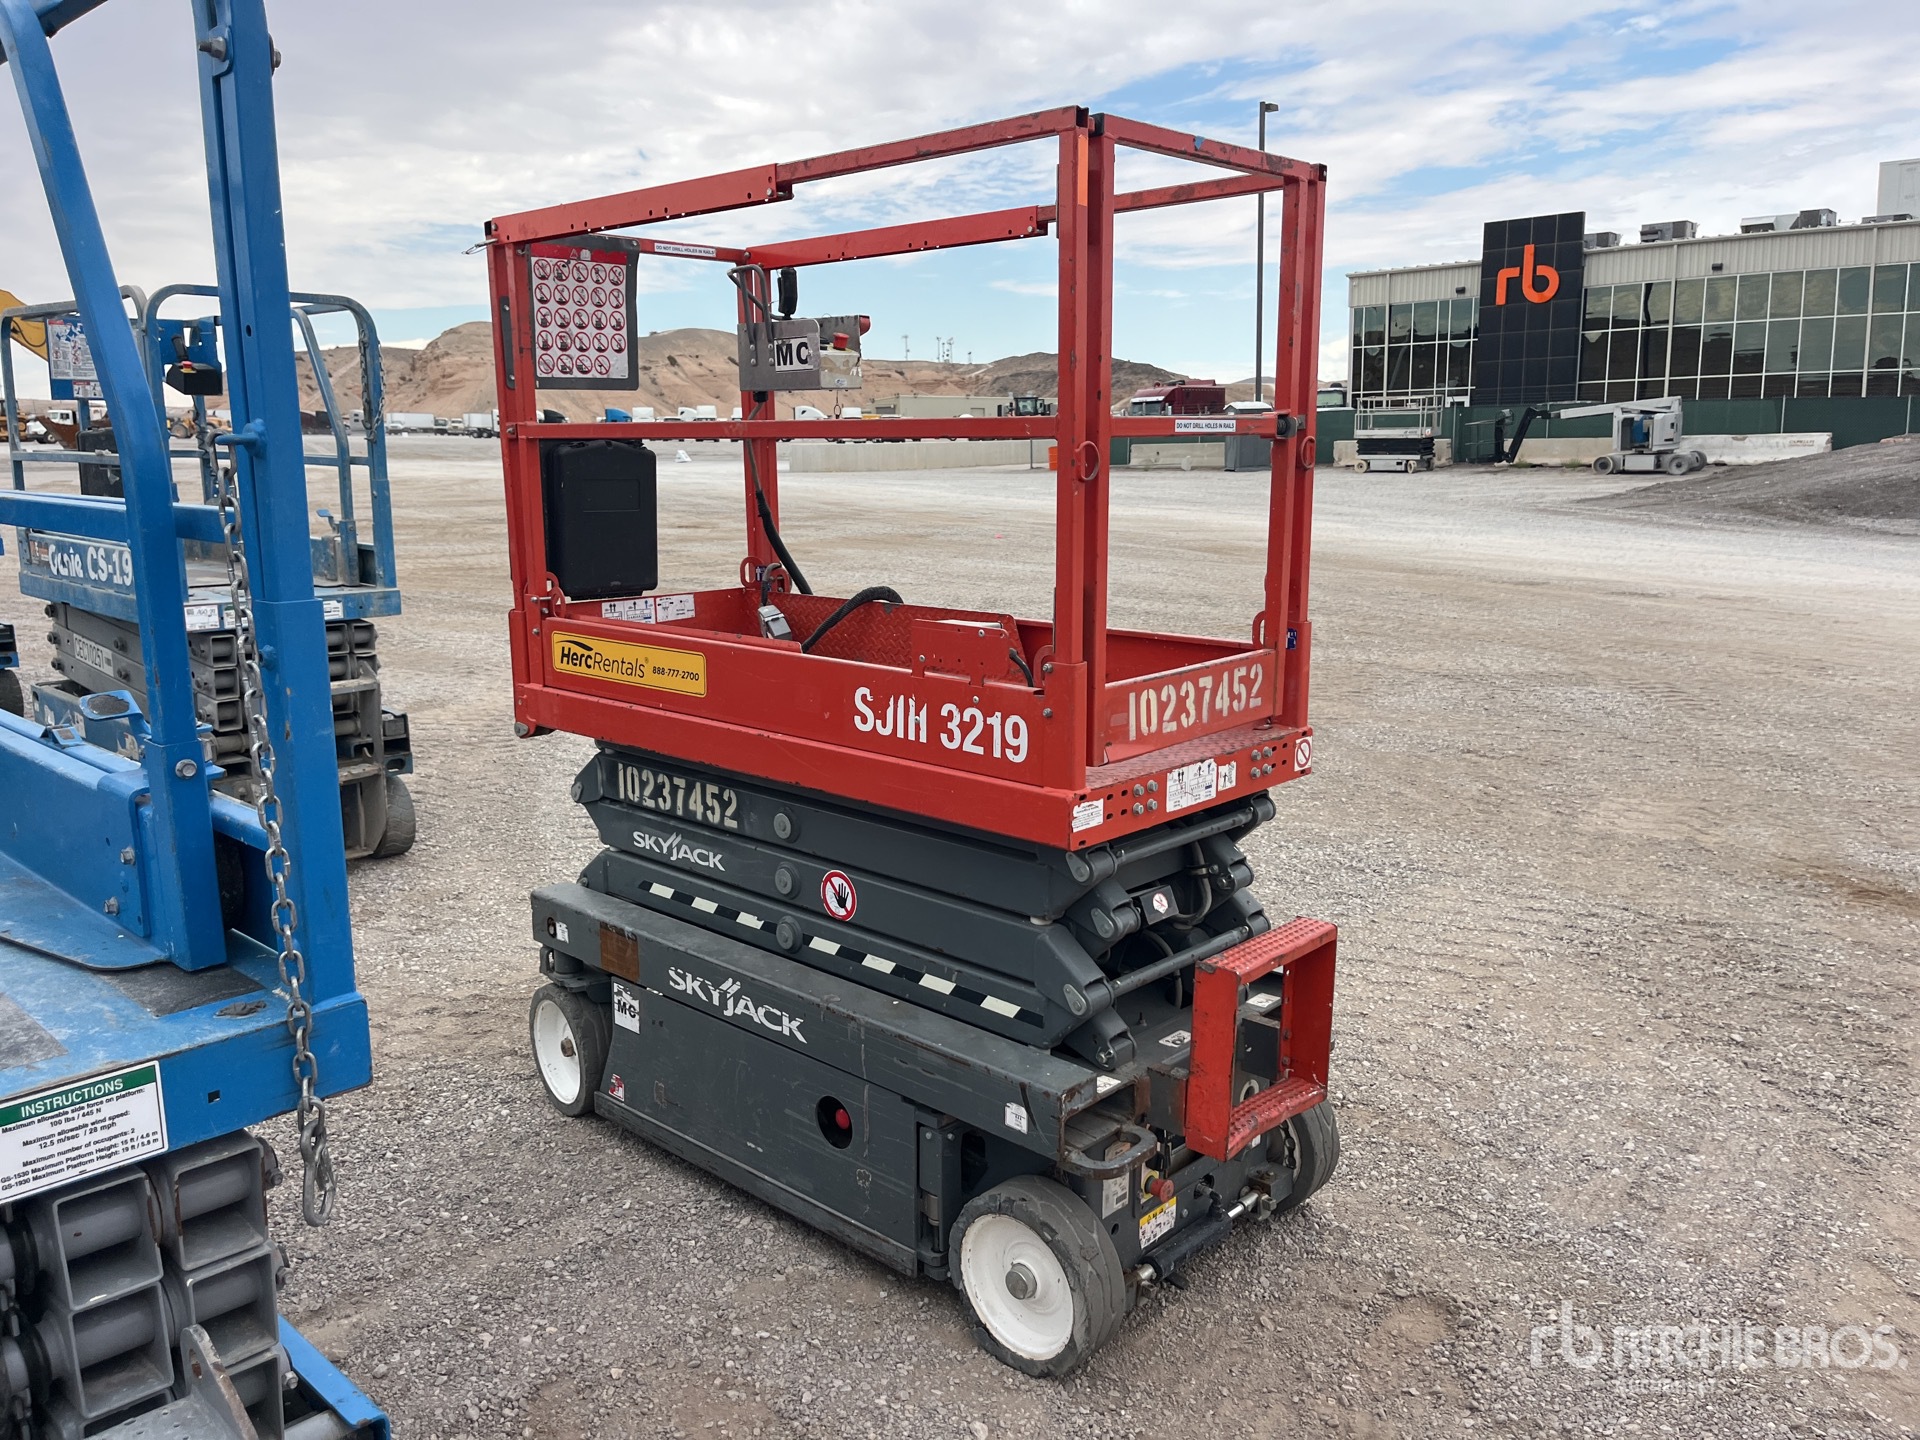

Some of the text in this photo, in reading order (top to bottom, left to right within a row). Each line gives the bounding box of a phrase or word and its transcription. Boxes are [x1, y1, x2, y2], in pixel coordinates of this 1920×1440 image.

[1495, 244, 1559, 305] rb
[776, 342, 809, 366] MC
[652, 666, 700, 682] 888-777-2700
[1128, 663, 1263, 741] 10237452
[940, 703, 1028, 763] 3219
[618, 762, 738, 829] 10237452
[632, 830, 726, 872] SKYJACK
[668, 966, 808, 1044] SKYJACK
[2, 1120, 35, 1134] Maximum
[37, 1110, 69, 1124] allowable
[71, 1105, 85, 1114] side
[87, 1100, 104, 1108] force
[116, 1088, 145, 1101] platform:
[21, 1078, 124, 1118] INSTRUCTIONS
[22, 1110, 130, 1147] Maximum allowable wind speed:
[39, 1140, 54, 1149] 12.5
[57, 1133, 80, 1144] m/sec
[100, 1121, 116, 1130] mph
[50, 1119, 62, 1127] 100
[82, 1109, 94, 1117] 445
[22, 1154, 55, 1167] Maximum
[57, 1145, 83, 1157] number
[93, 1131, 130, 1145] occupants:
[31, 1160, 64, 1174] Maximum
[65, 1151, 94, 1163] Platform
[95, 1143, 119, 1154] Height:
[32, 1168, 65, 1181] Maximum
[66, 1158, 95, 1170] Platform
[96, 1150, 120, 1162] Height:
